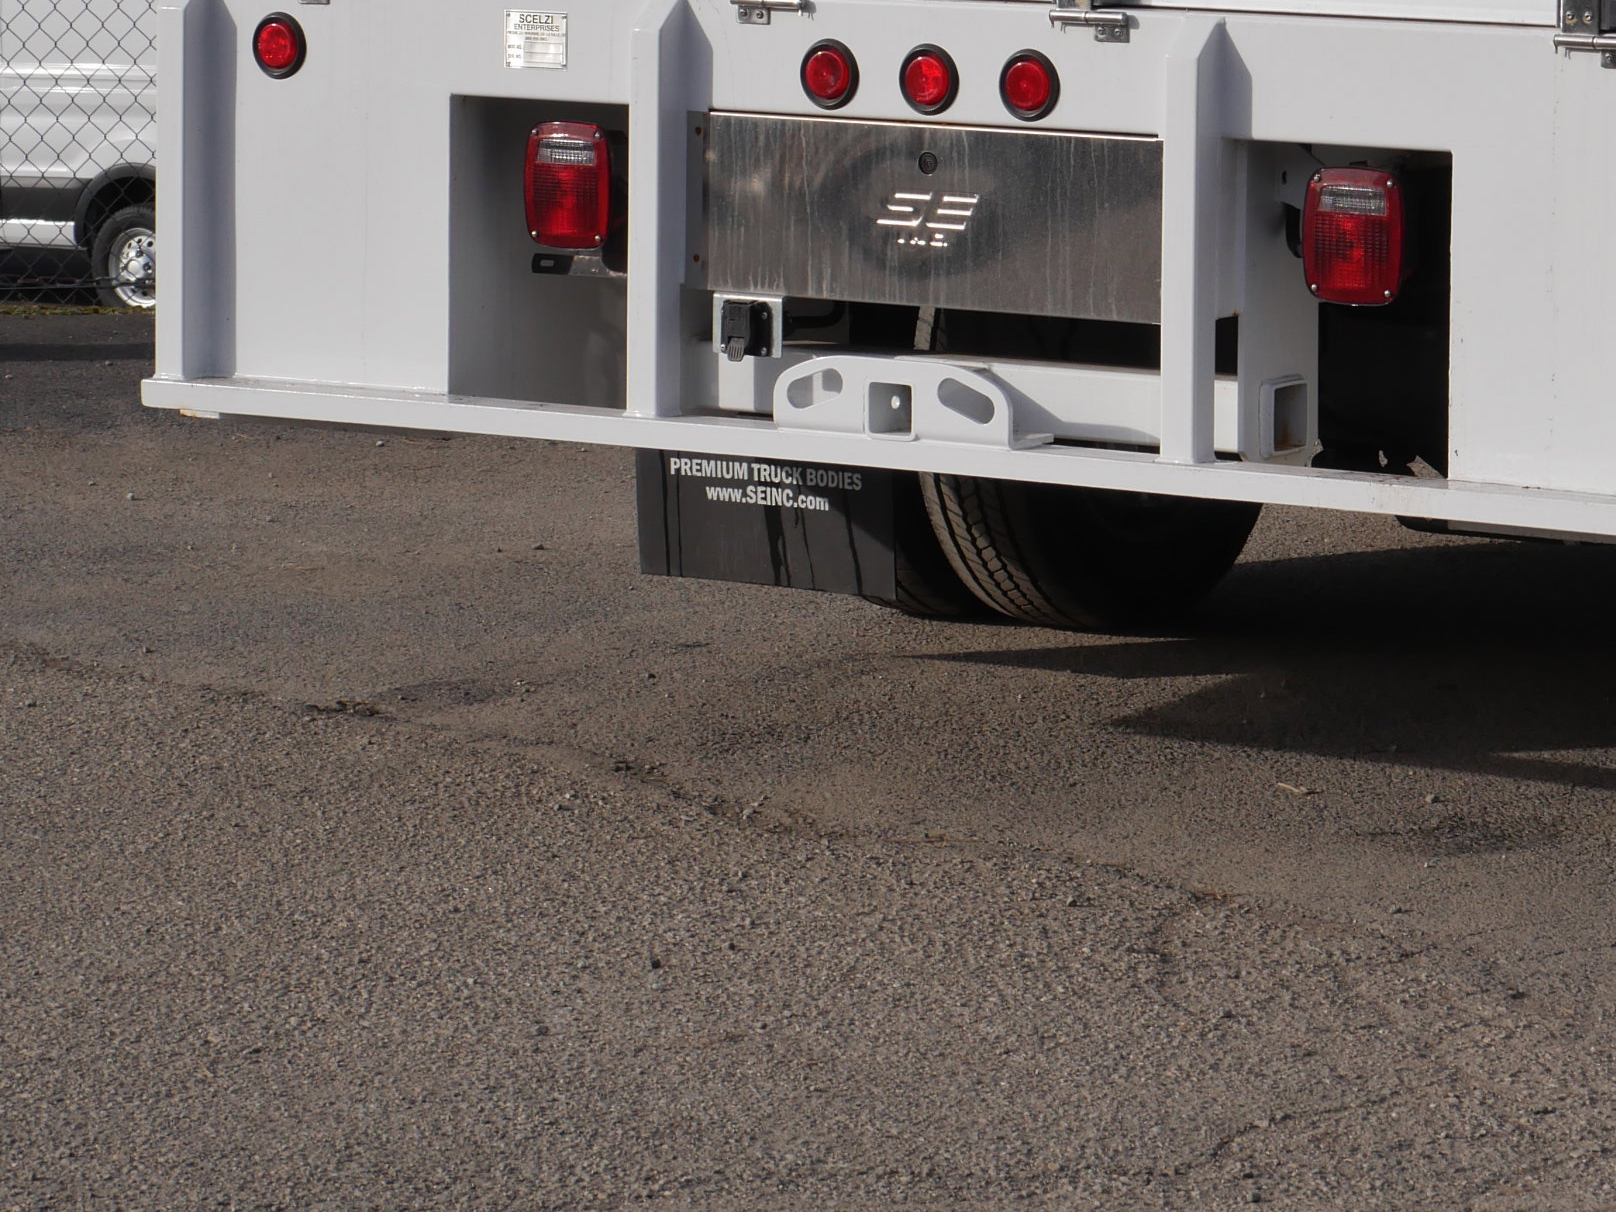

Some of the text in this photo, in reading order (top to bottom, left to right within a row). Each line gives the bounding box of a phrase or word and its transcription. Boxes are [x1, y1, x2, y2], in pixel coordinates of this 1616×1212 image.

[513, 23, 560, 32] ENTERPRISES
[519, 13, 554, 25] SCELZI
[669, 457, 863, 491] PREMIUM TRUCK BODIES
[705, 485, 830, 511] www.SEINC.com
